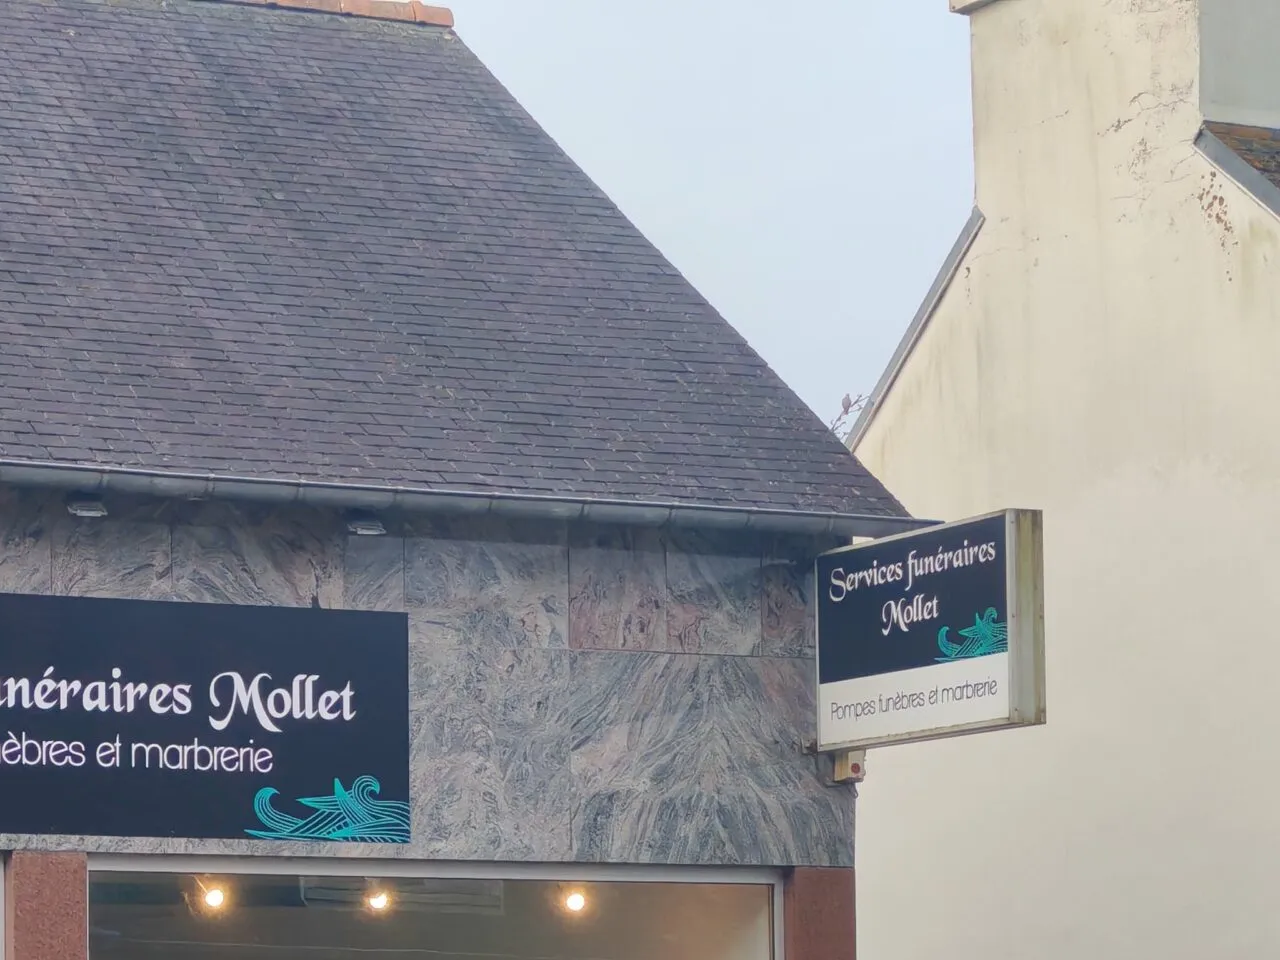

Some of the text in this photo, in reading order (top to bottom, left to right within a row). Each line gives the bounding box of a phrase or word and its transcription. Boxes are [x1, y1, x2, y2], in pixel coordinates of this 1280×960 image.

[829, 540, 996, 602] Services funéraires
[882, 594, 939, 636] Mollet
[209, 671, 357, 733] Mollet
[830, 676, 998, 721] Pompes funèbres et marbrerie
[96, 733, 122, 768] et
[132, 738, 273, 773] marbrerie
